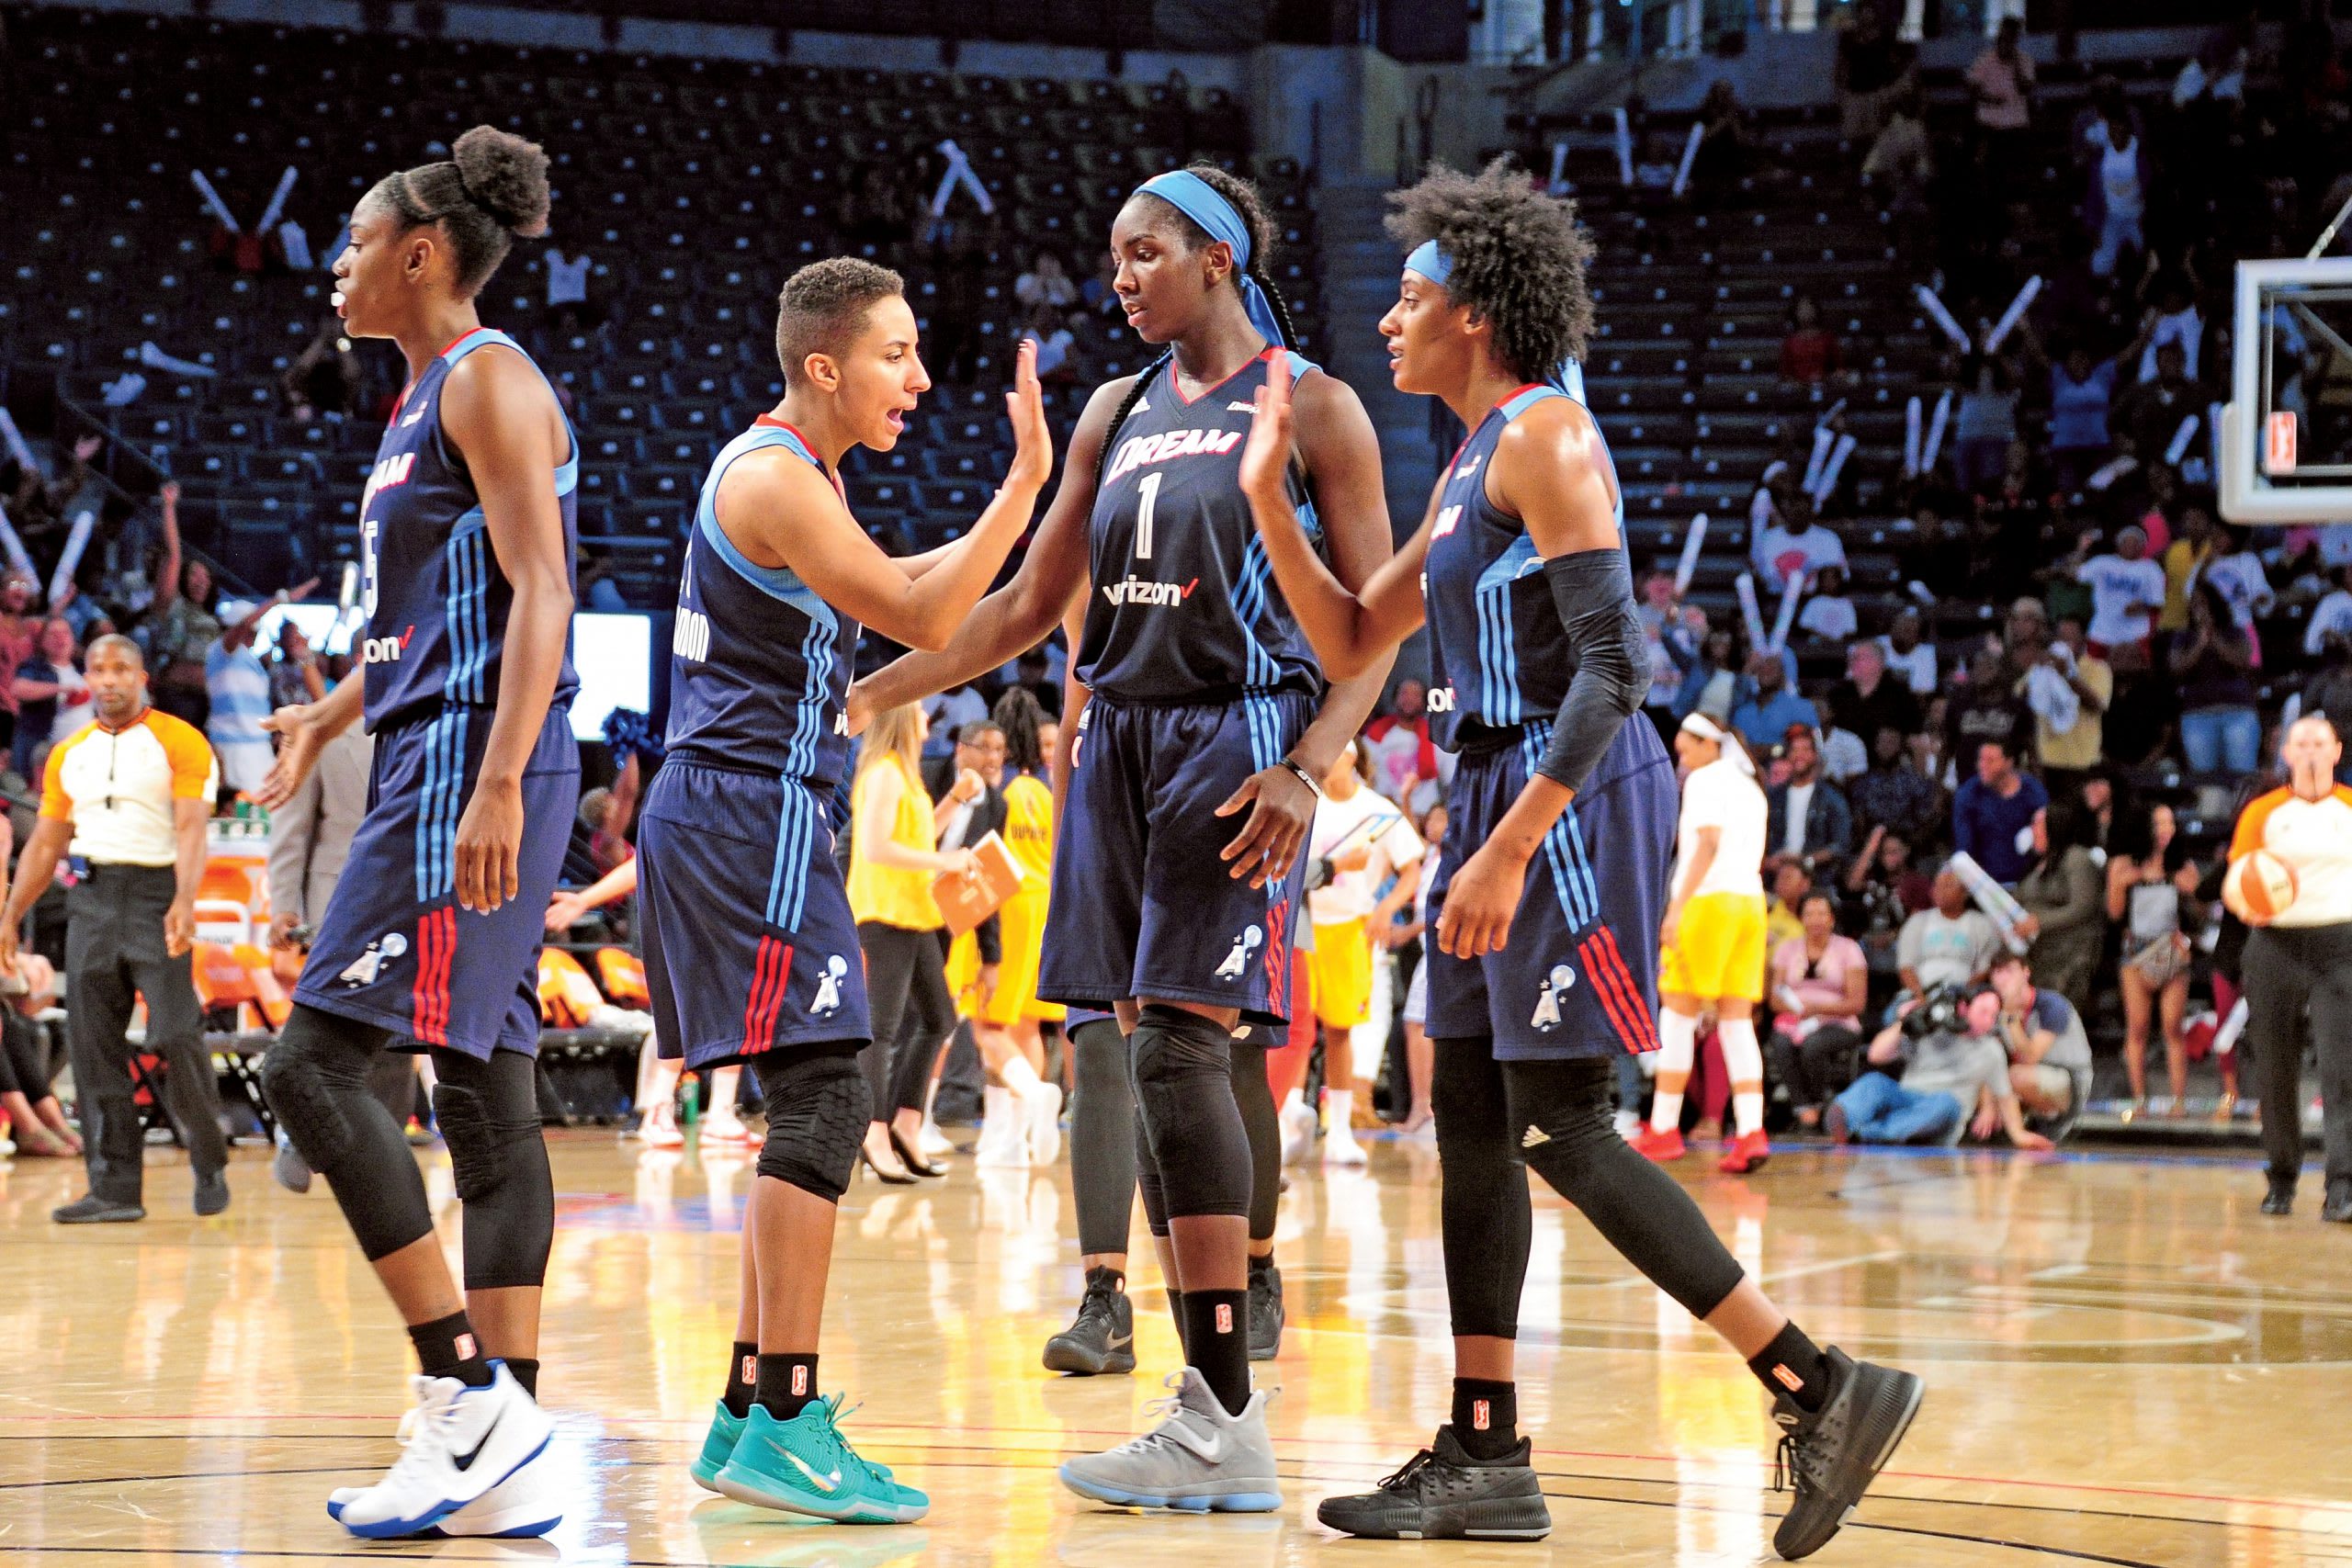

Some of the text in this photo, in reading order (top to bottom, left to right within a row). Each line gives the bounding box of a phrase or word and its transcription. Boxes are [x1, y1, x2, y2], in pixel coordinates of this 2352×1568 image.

[1104, 429, 1242, 487] DREAM
[1136, 471, 1163, 559] 1
[1102, 573, 1182, 607] vrizon
